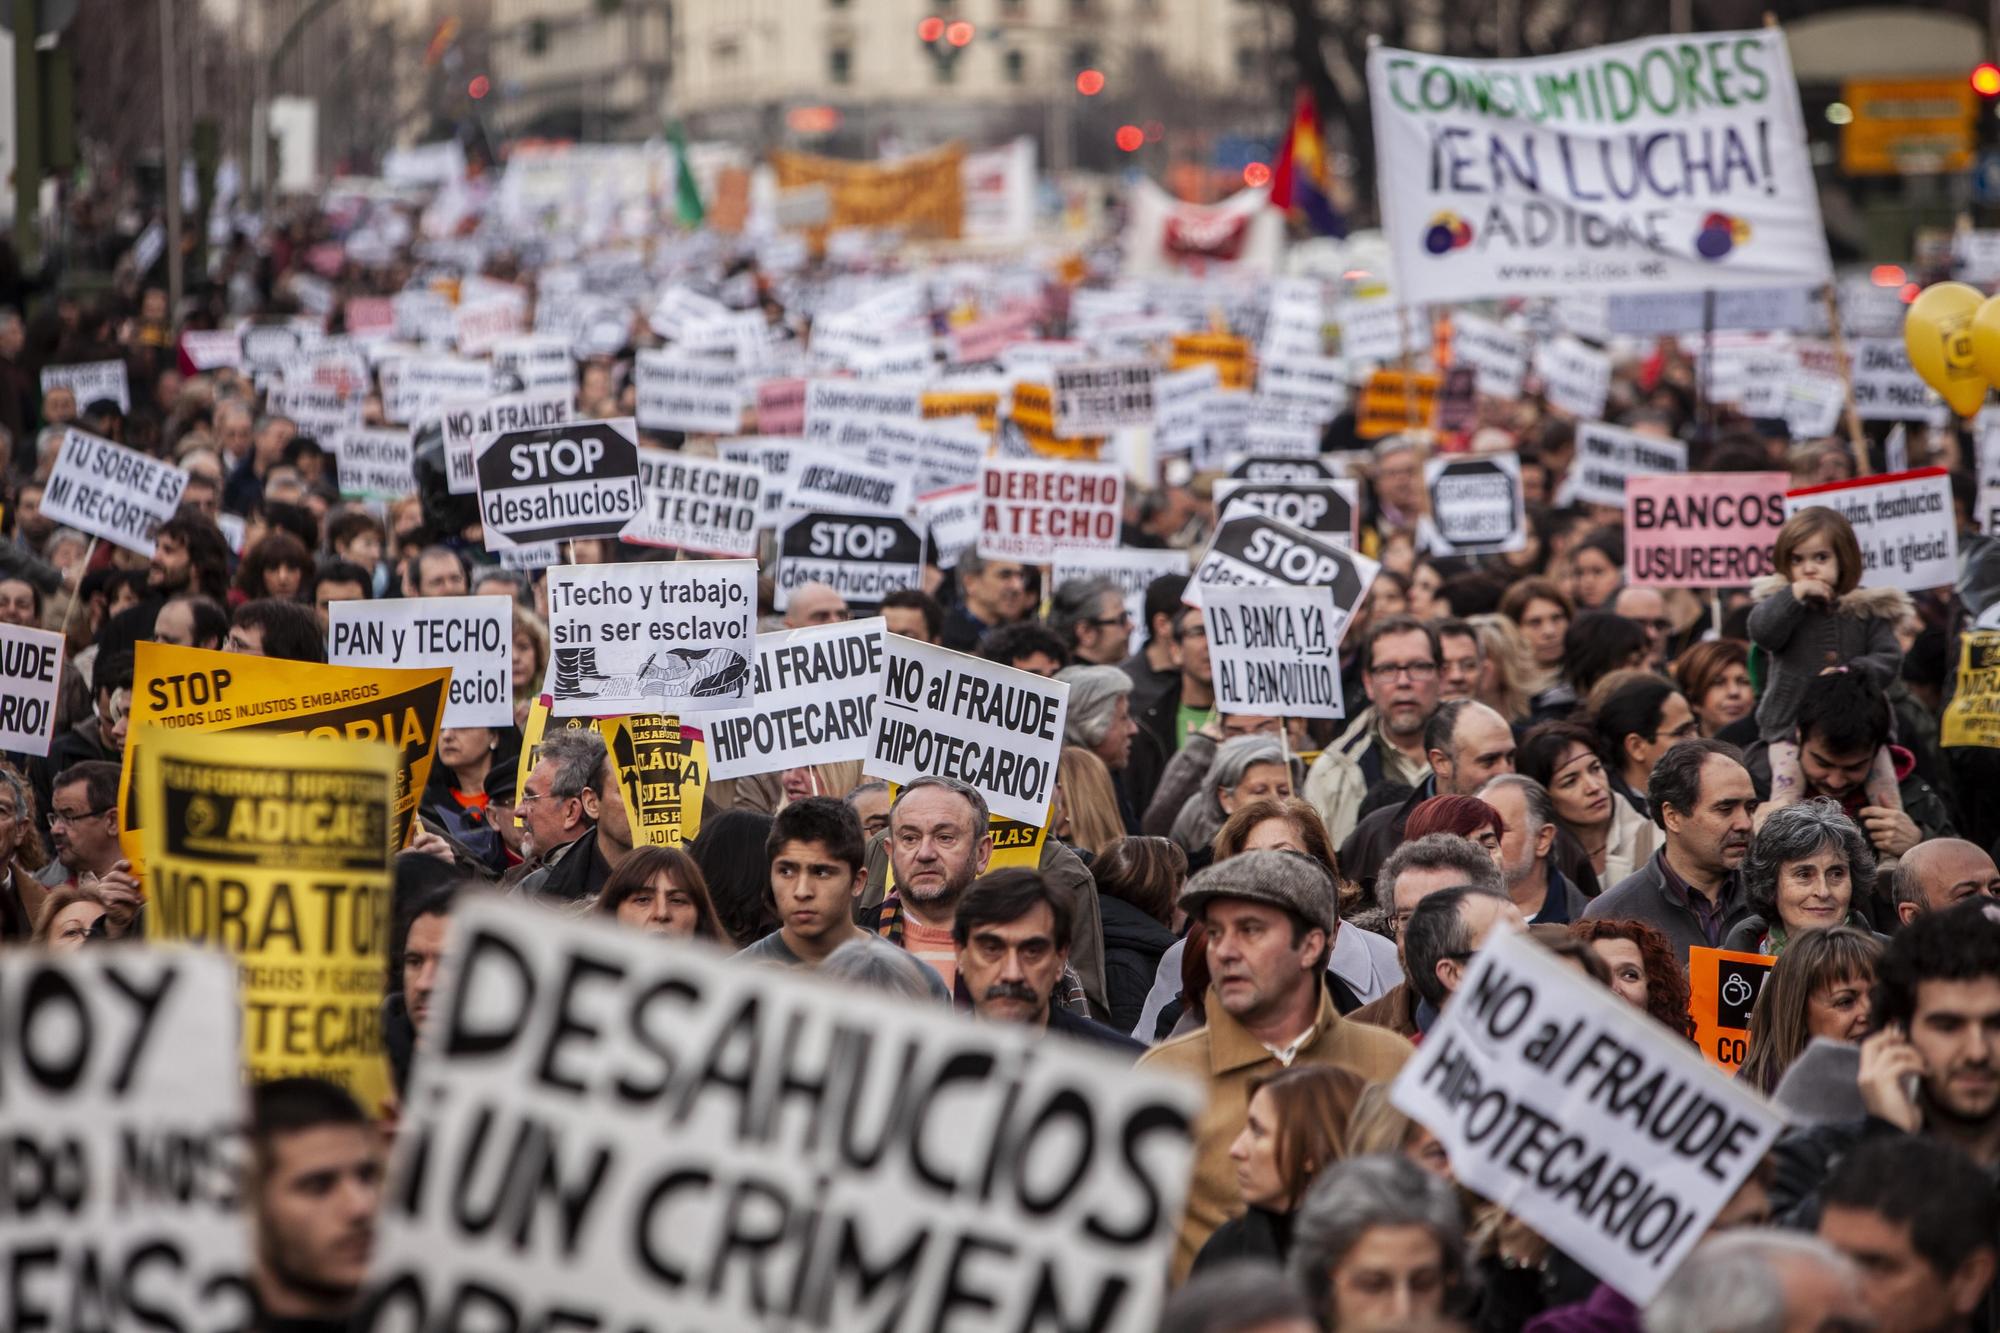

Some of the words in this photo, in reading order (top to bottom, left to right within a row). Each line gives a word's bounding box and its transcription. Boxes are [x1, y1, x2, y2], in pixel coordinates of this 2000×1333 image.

[1387, 39, 1770, 122] CONSUMIDORES
[1559, 119, 1780, 200] LUCHA!
[447, 411, 473, 437] NO
[478, 412, 493, 432] al
[498, 401, 567, 430] FRAUDE
[65, 437, 89, 468] TU
[92, 445, 158, 496] SOBRE
[155, 469, 182, 505] ES
[509, 437, 605, 481] STOP
[639, 459, 760, 501] DERECHO
[48, 475, 72, 506] MI
[486, 480, 639, 527] desahucios!
[985, 470, 1118, 505] DERECHO
[657, 497, 754, 533] TECHO
[983, 504, 998, 532] A
[1008, 506, 1114, 540] TECHO
[1634, 494, 1785, 529] BANCOS
[809, 520, 897, 560] STOP
[1243, 527, 1340, 586] STOP
[552, 580, 632, 613] ¡Techo
[640, 585, 653, 610] y
[660, 578, 748, 609] trabajo,
[333, 621, 383, 656] PAN
[392, 629, 406, 663] y
[413, 617, 507, 657] TECHO,
[554, 618, 592, 643] sin
[601, 620, 642, 641] ser
[649, 614, 748, 641] esclavo!
[1210, 606, 1236, 646] LA
[1240, 604, 1303, 655] BANCA,
[0, 639, 57, 683] UDE
[776, 633, 882, 691] FRAUDE
[1220, 659, 1242, 703] AL
[1246, 658, 1338, 709] BANQUILLO.
[149, 669, 232, 712] STOP
[160, 711, 205, 730] TODOS
[208, 708, 231, 723] LOS
[236, 697, 298, 718] INJUSTOS
[302, 683, 381, 709] EMBARGOS
[886, 655, 924, 703] NO
[927, 670, 952, 712] al
[952, 673, 1060, 742] FRAUDE
[875, 717, 1050, 804] HIPOTECARIO!
[650, 829, 680, 845] ADIC
[0, 962, 179, 1097] OY
[1471, 961, 1536, 1042] NO
[1522, 1018, 1585, 1078] al
[1564, 1030, 1760, 1182] FRAUDE
[1422, 1035, 1696, 1267] HIPOTECARIO!
